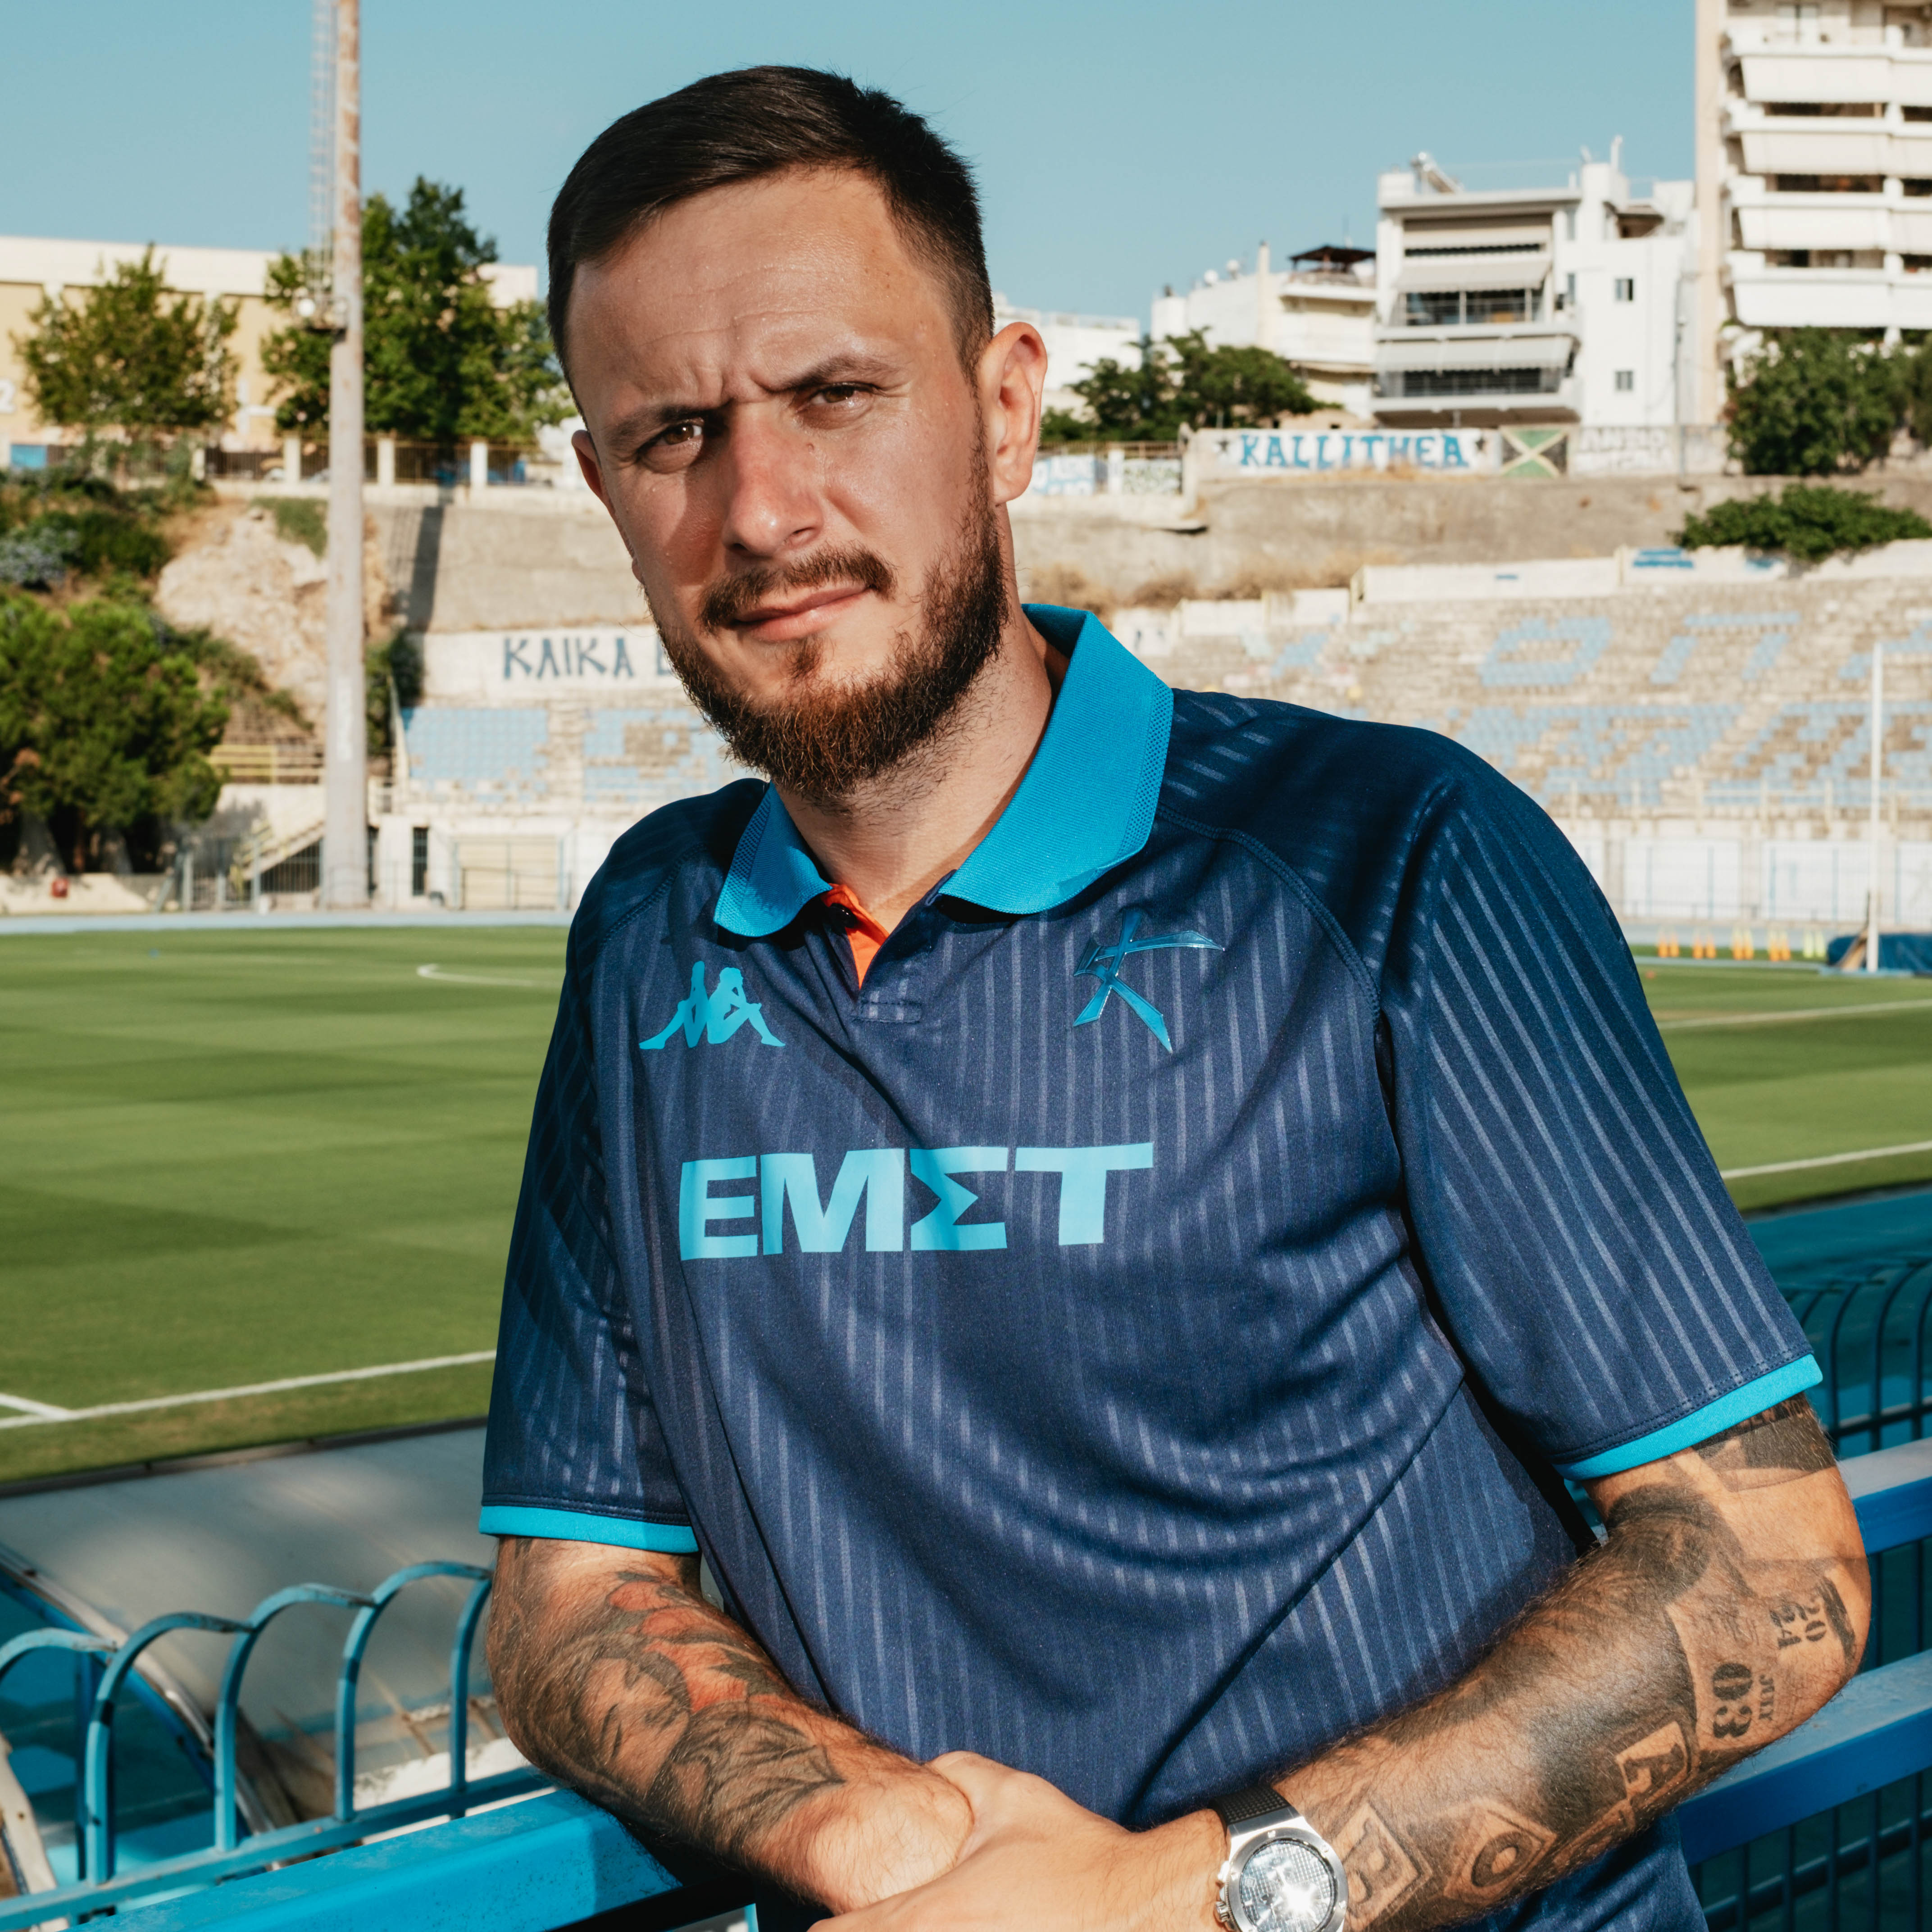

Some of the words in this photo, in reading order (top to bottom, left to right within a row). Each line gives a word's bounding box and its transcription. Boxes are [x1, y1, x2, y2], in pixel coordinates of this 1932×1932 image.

[1240, 435, 1469, 469] KALLITHEA
[678, 1141, 1154, 1261] ΕΜΣΤ
[1712, 1664, 1753, 1739] 03
[1759, 1675, 1775, 1721] JULY
